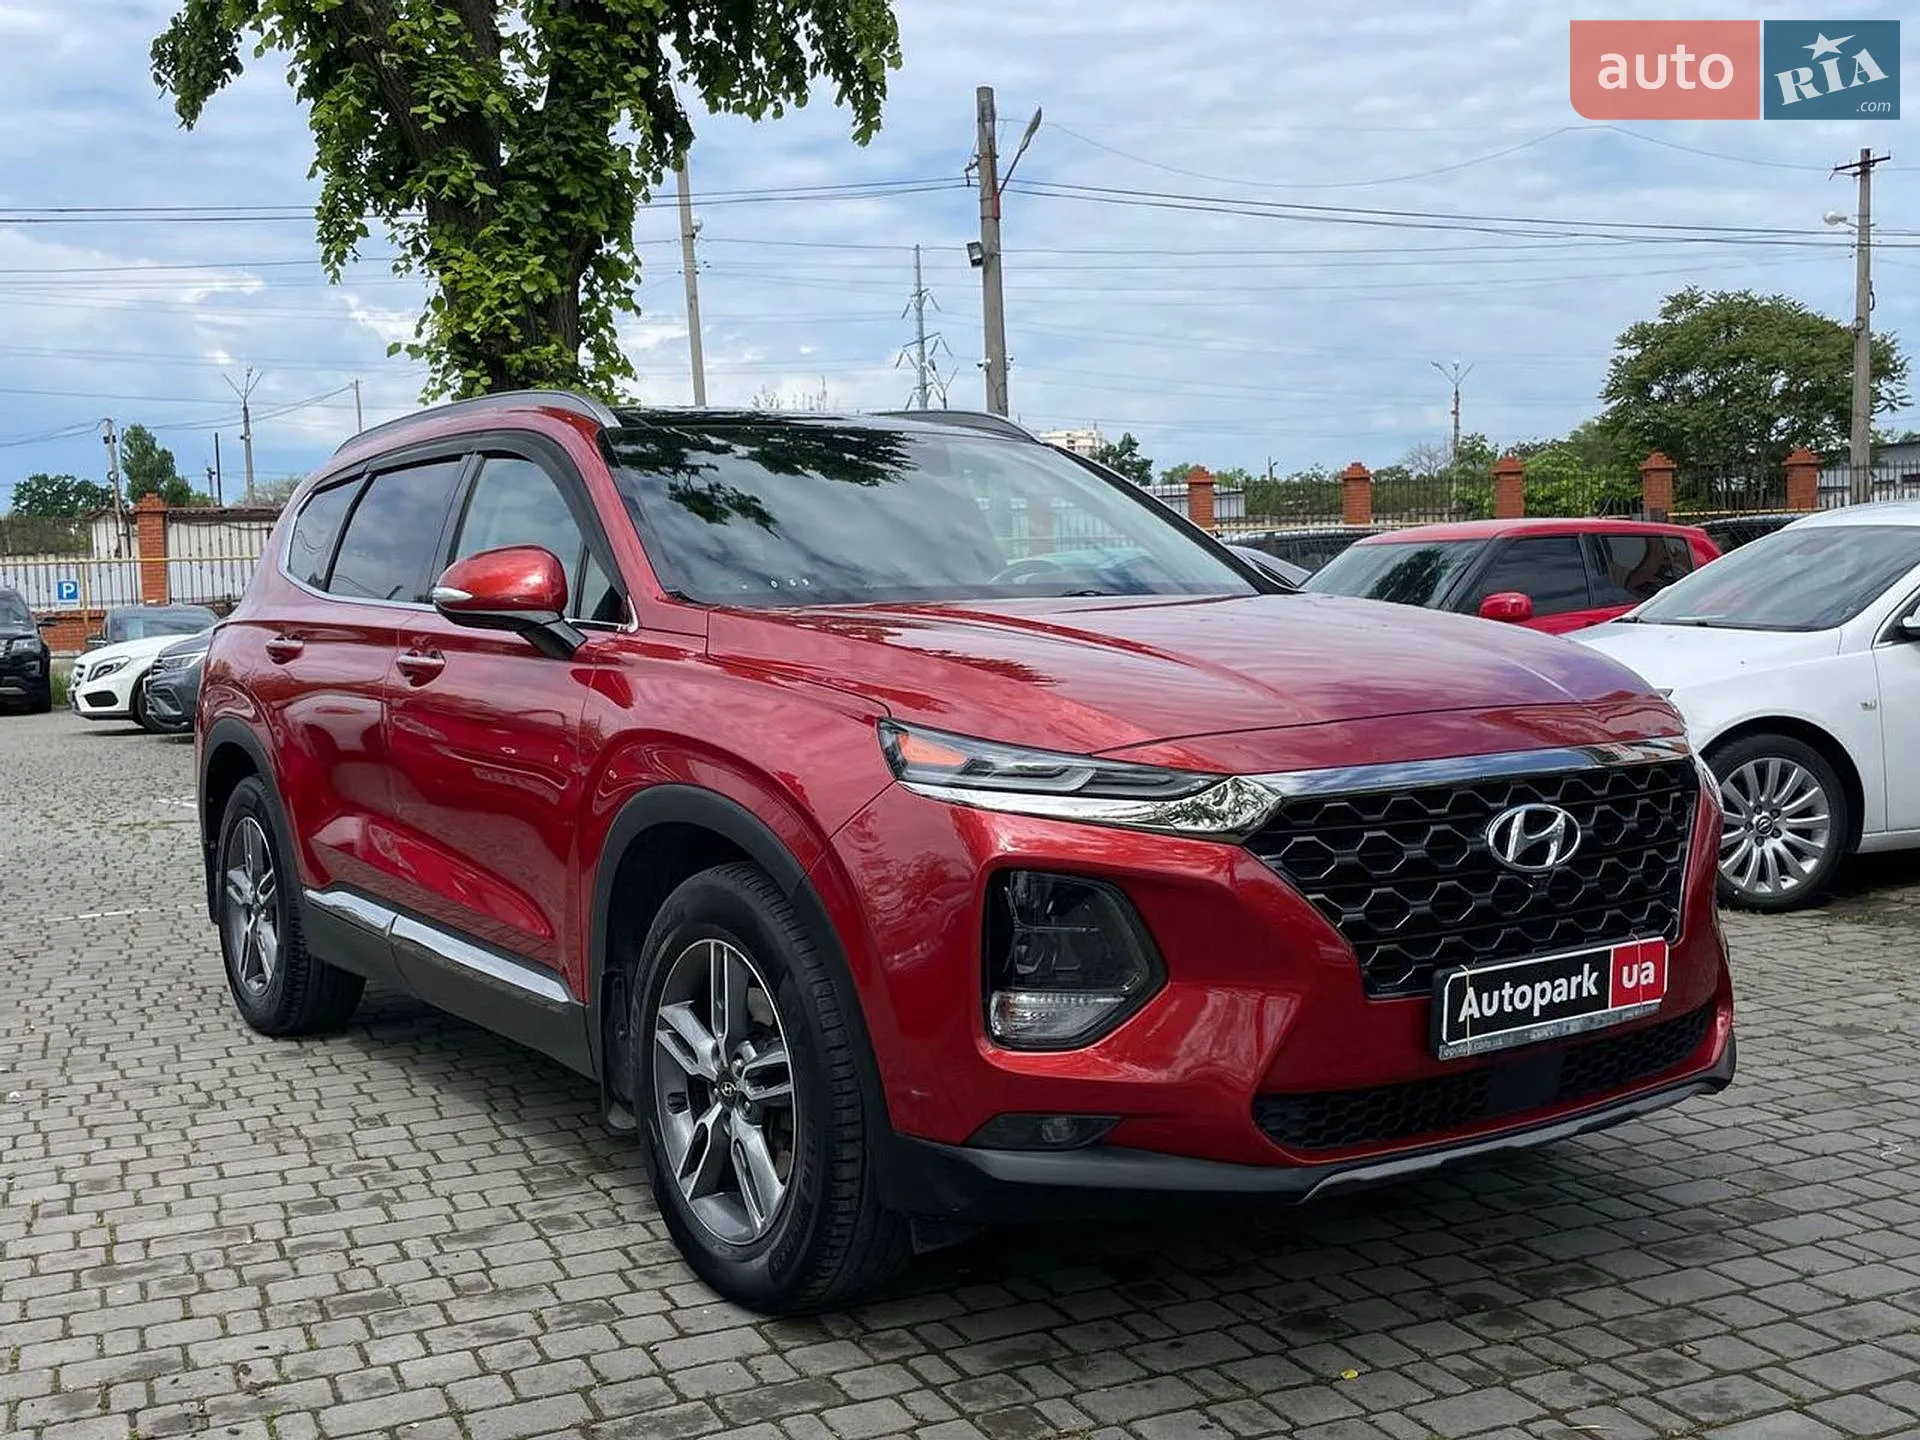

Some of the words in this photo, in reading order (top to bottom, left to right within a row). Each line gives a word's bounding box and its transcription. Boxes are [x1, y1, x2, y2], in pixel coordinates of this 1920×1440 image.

[62, 582, 75, 599] P
[1457, 963, 1599, 1023] Autopark
[1622, 960, 1655, 990] ua
